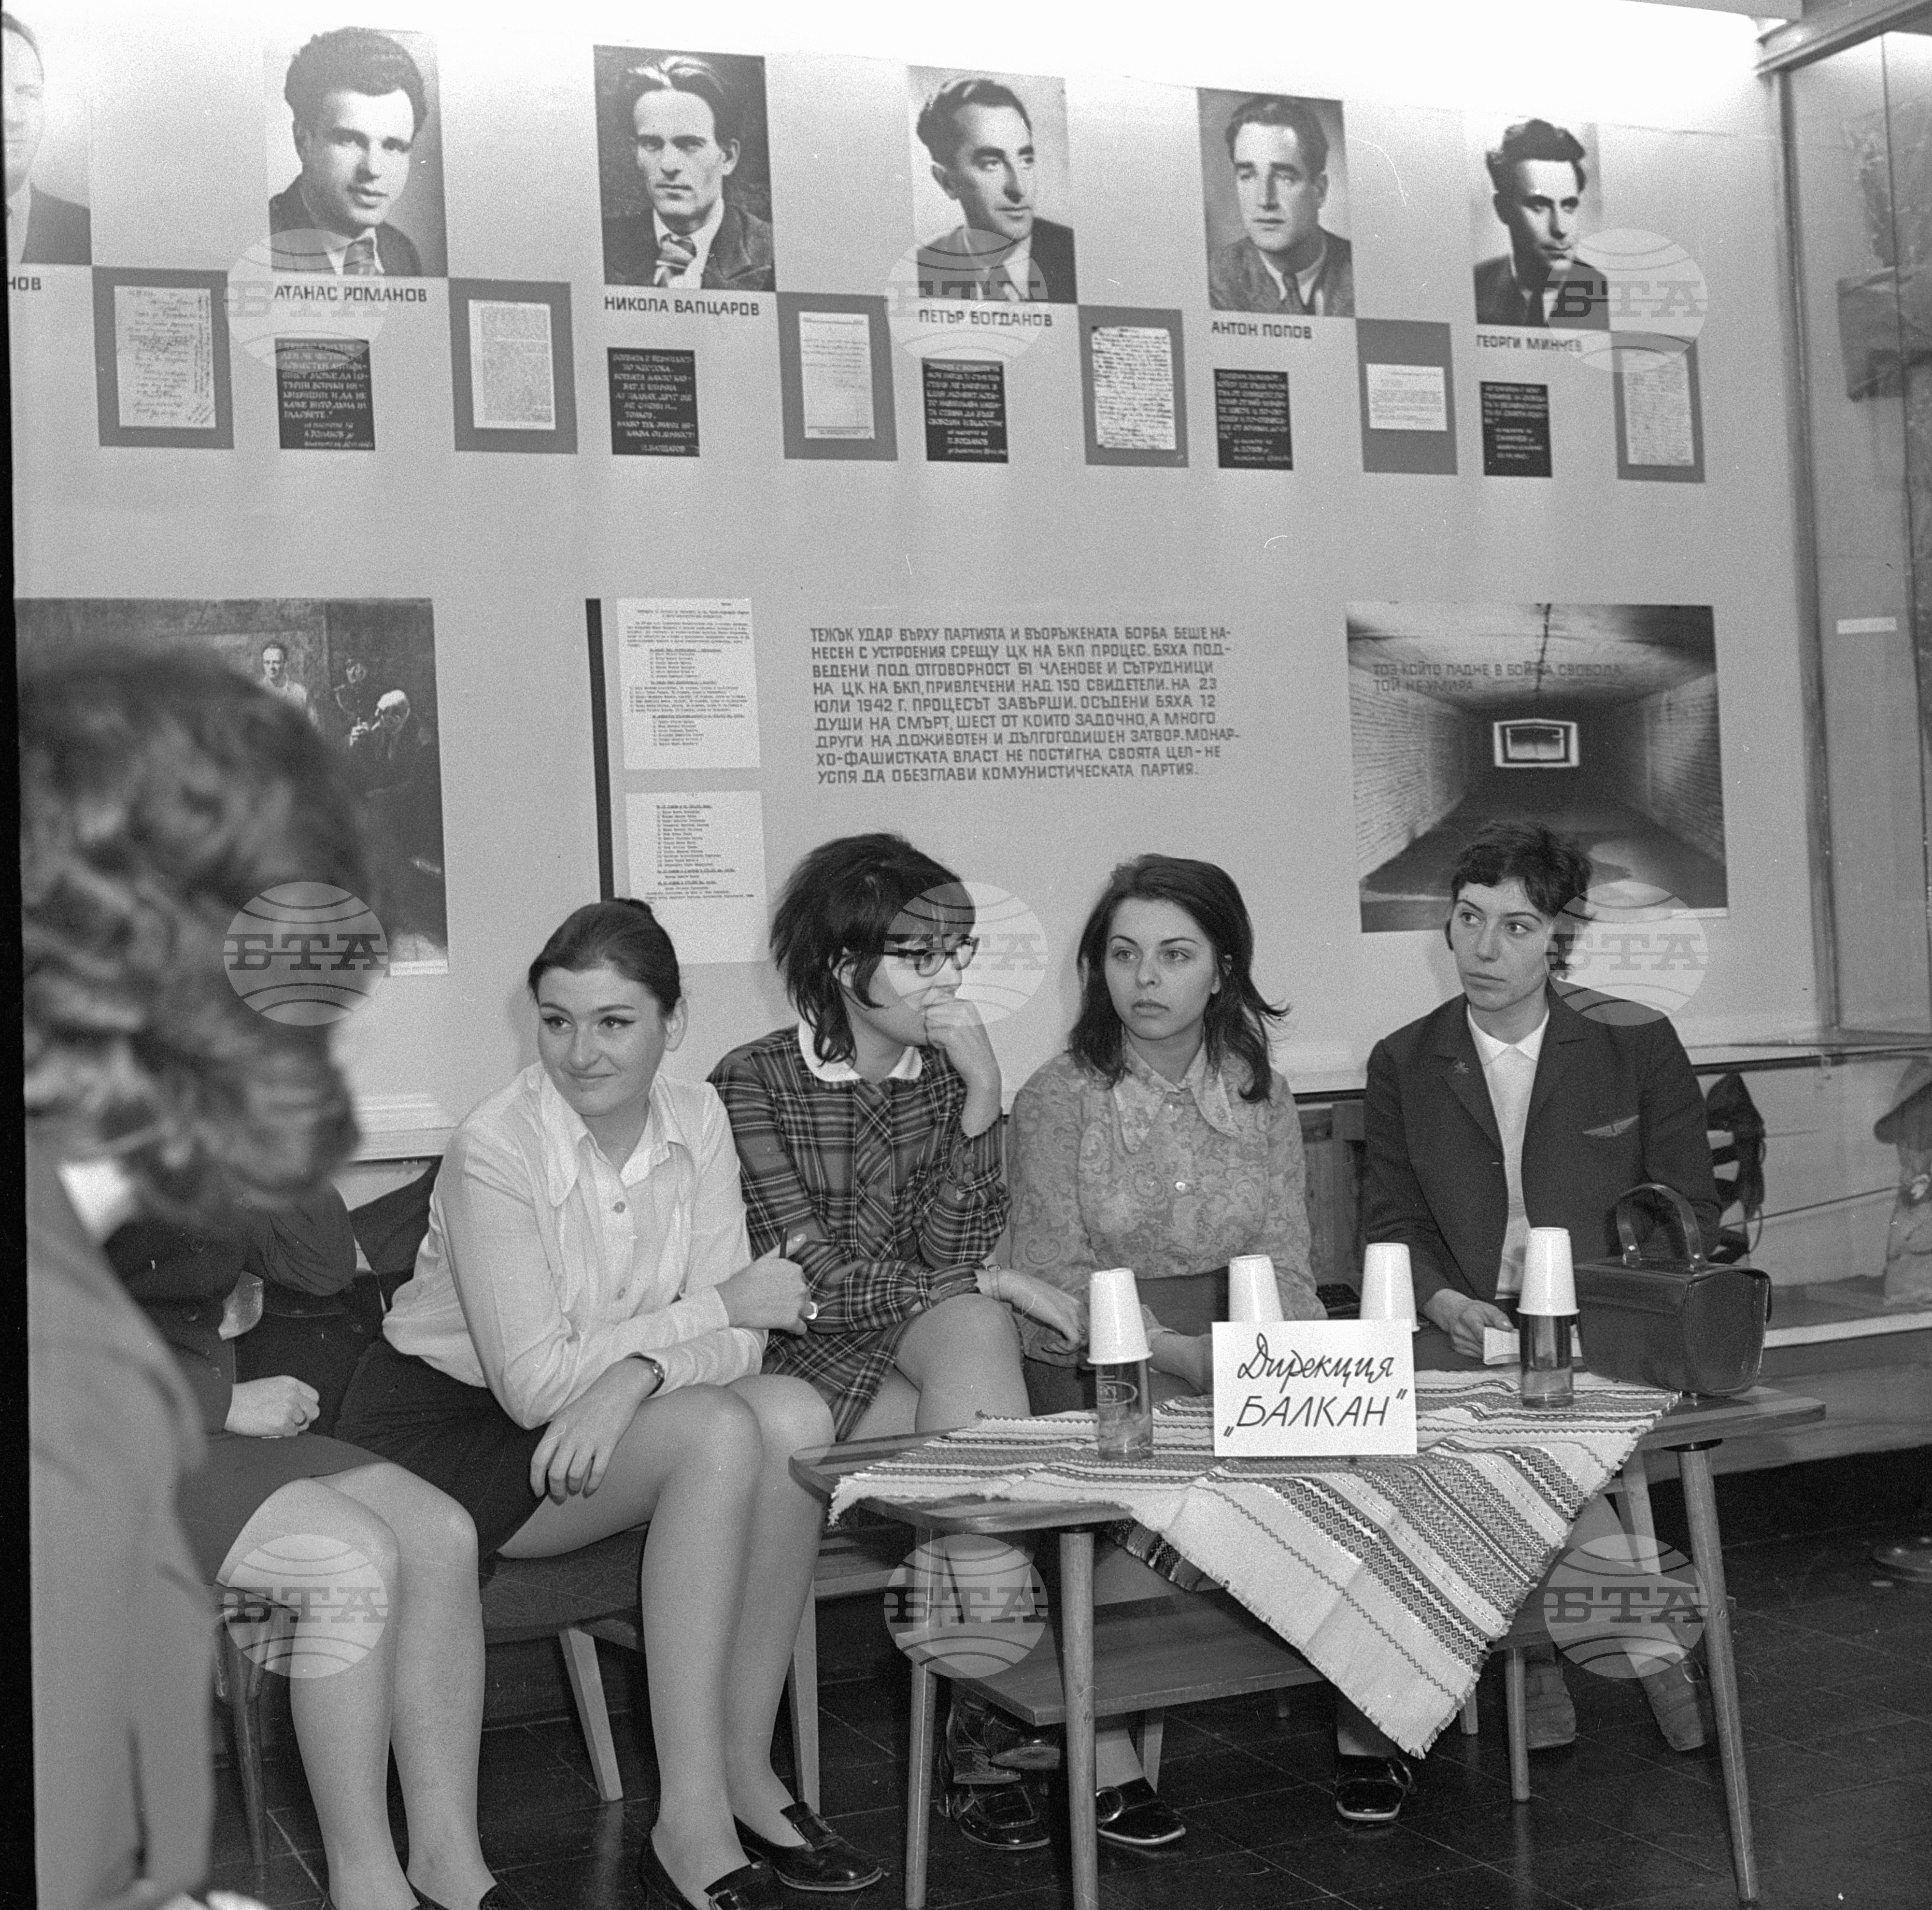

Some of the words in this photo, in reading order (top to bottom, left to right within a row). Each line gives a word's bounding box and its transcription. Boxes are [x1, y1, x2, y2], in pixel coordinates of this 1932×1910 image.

[274, 285, 338, 300] АТАНАС
[344, 287, 427, 302] РОМАНОВ
[604, 296, 668, 312] НИКОЛА
[675, 299, 759, 315] ВАПЦАРОВ
[920, 309, 963, 324] ПЕТЪР
[970, 311, 1052, 327] БОГДАНОВ
[1211, 321, 1257, 336] АНТОН
[1263, 324, 1311, 339] ПОПОВ
[1477, 335, 1520, 348] ГЕОРГИ
[810, 627, 853, 642] ТЕЖЪК
[858, 627, 892, 641] УДАР
[900, 627, 939, 641] ВЪРХУ
[944, 627, 1006, 640] ПАРТИЯТА
[1010, 628, 1019, 640] И
[1024, 627, 1118, 640] ВЪОРЪЖЕНАТА
[1125, 627, 1167, 639] БОРБА
[1174, 626, 1207, 640] БЕШЕ
[811, 647, 853, 659] НЕСЕН
[859, 646, 867, 659] С
[872, 645, 945, 658] УСТРОЕНИЯ
[951, 645, 998, 660] СРЕЩУ
[1007, 645, 1027, 659] ЦК
[1033, 644, 1051, 657] НА
[1058, 644, 1084, 657] БКП
[1092, 644, 1150, 659] ПРОЦЕС.
[1154, 643, 1187, 656] БЯХА
[1193, 643, 1231, 656] ПОД-
[812, 664, 868, 678] ВЕДЕНИ
[877, 664, 909, 676] ПОД
[916, 663, 1010, 676] ОТГОВОРНОСТ
[1040, 662, 1101, 675] ЧЛЕНОВЕ
[1108, 662, 1116, 673] И
[1123, 661, 1213, 675] СЪТРУДНИЦИ
[1446, 664, 1489, 676] ПАДНЕ
[1494, 664, 1503, 676] В
[813, 682, 833, 695] НА
[842, 683, 864, 697] ЦК
[869, 681, 888, 694] НА
[926, 680, 1014, 693] ПРИВЛЕЧЕНИ
[1023, 680, 1051, 692] НАД
[1057, 679, 1080, 692] 150
[1087, 678, 1168, 691] СВИДЕТЕЛИ.
[1172, 678, 1189, 690] НА
[1200, 678, 1217, 690] 23
[814, 699, 850, 713] ЮЛИ
[857, 698, 892, 712] 1942
[898, 698, 907, 711] Г.
[913, 697, 990, 713] ПРОЦЕСЪТ
[998, 696, 1077, 710] ЗАВЪРШИ.
[1081, 695, 1148, 709] ОСЪДЕНИ
[1156, 695, 1192, 707] БЯХА
[1200, 695, 1215, 707] 12
[814, 717, 862, 731] ДУШИ
[870, 717, 890, 730] НА
[957, 715, 995, 728] ШЕСТ
[1002, 714, 1017, 727] ОТ
[1023, 714, 1069, 727] КОИТО
[1151, 713, 1159, 724] А
[1165, 712, 1215, 725] МНОГО
[816, 736, 862, 748] ДРУГИ
[871, 735, 892, 746] НА
[896, 733, 987, 746] ДОЖИВОТЕН
[994, 733, 1002, 744] И
[1009, 730, 1124, 744] ДЪЛГОГОДИШЕН
[1131, 729, 1183, 742] ЗАТВОР.
[817, 750, 948, 766] ХО-ФАШИСТКАТА
[953, 750, 998, 763] ВЛАСТ
[1007, 749, 1022, 762] НЕ
[1030, 747, 1101, 761] ПОСТИГНА
[1109, 747, 1160, 760] СВОЯТА
[1205, 746, 1220, 758] НЕ
[818, 770, 857, 784] УСПЯ
[862, 769, 885, 783] ДА
[892, 767, 976, 783] ОБЕЗГЛАВИ
[982, 764, 1134, 780] КОМУНИСТИЧЕСКАТА
[1141, 762, 1198, 777] ПАРТИЯ.
[1237, 1332, 1394, 1394] Дирекция
